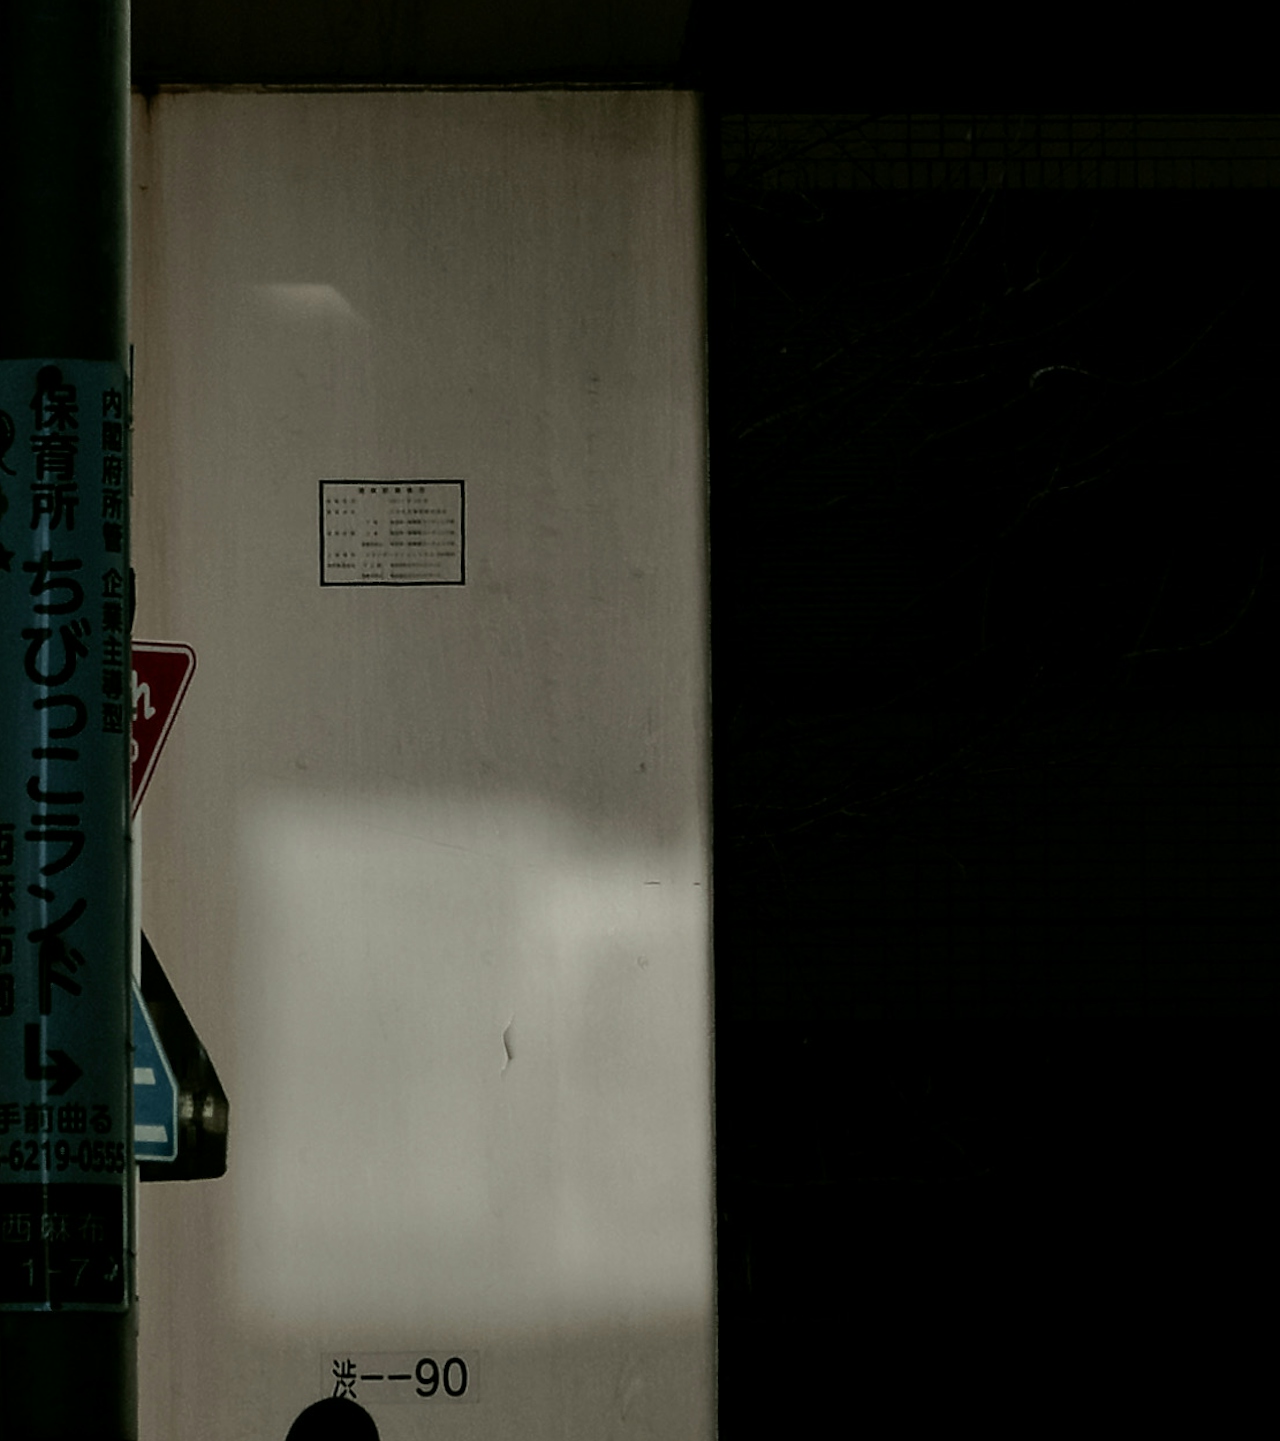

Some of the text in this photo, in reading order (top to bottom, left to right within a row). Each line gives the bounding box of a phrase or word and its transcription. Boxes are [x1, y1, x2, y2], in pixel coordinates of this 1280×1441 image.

[21, 382, 92, 1015] 保育所 ちびっこランド
